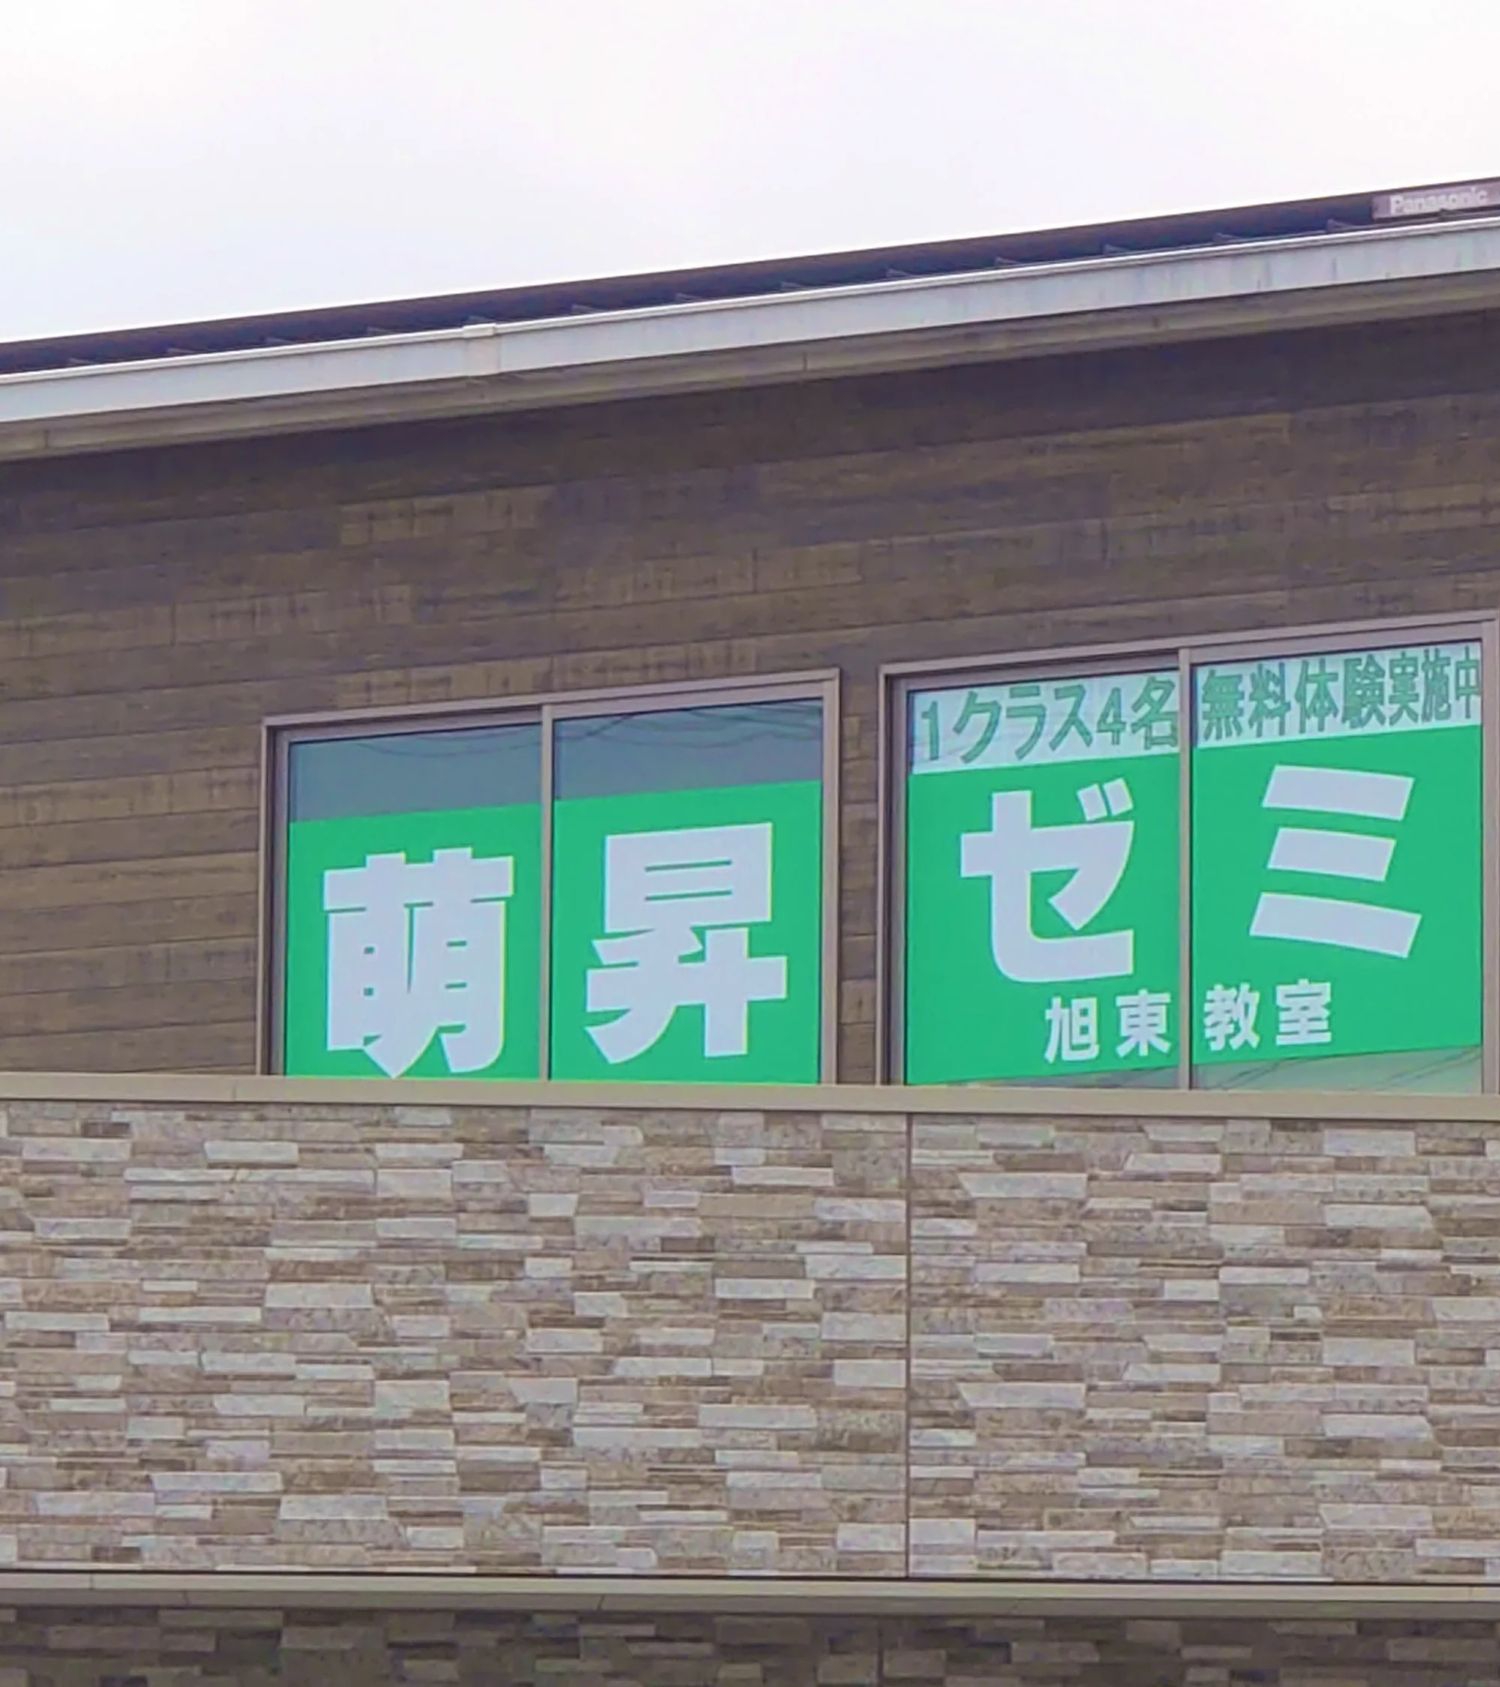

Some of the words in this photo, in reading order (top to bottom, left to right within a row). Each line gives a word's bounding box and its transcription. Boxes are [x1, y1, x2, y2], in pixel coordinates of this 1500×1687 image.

[1389, 185, 1490, 216] Panasonic
[921, 675, 1181, 764] 1クラス4名
[1201, 645, 1483, 743] 無料体験実施中
[1043, 978, 1333, 1064] 旭東教室
